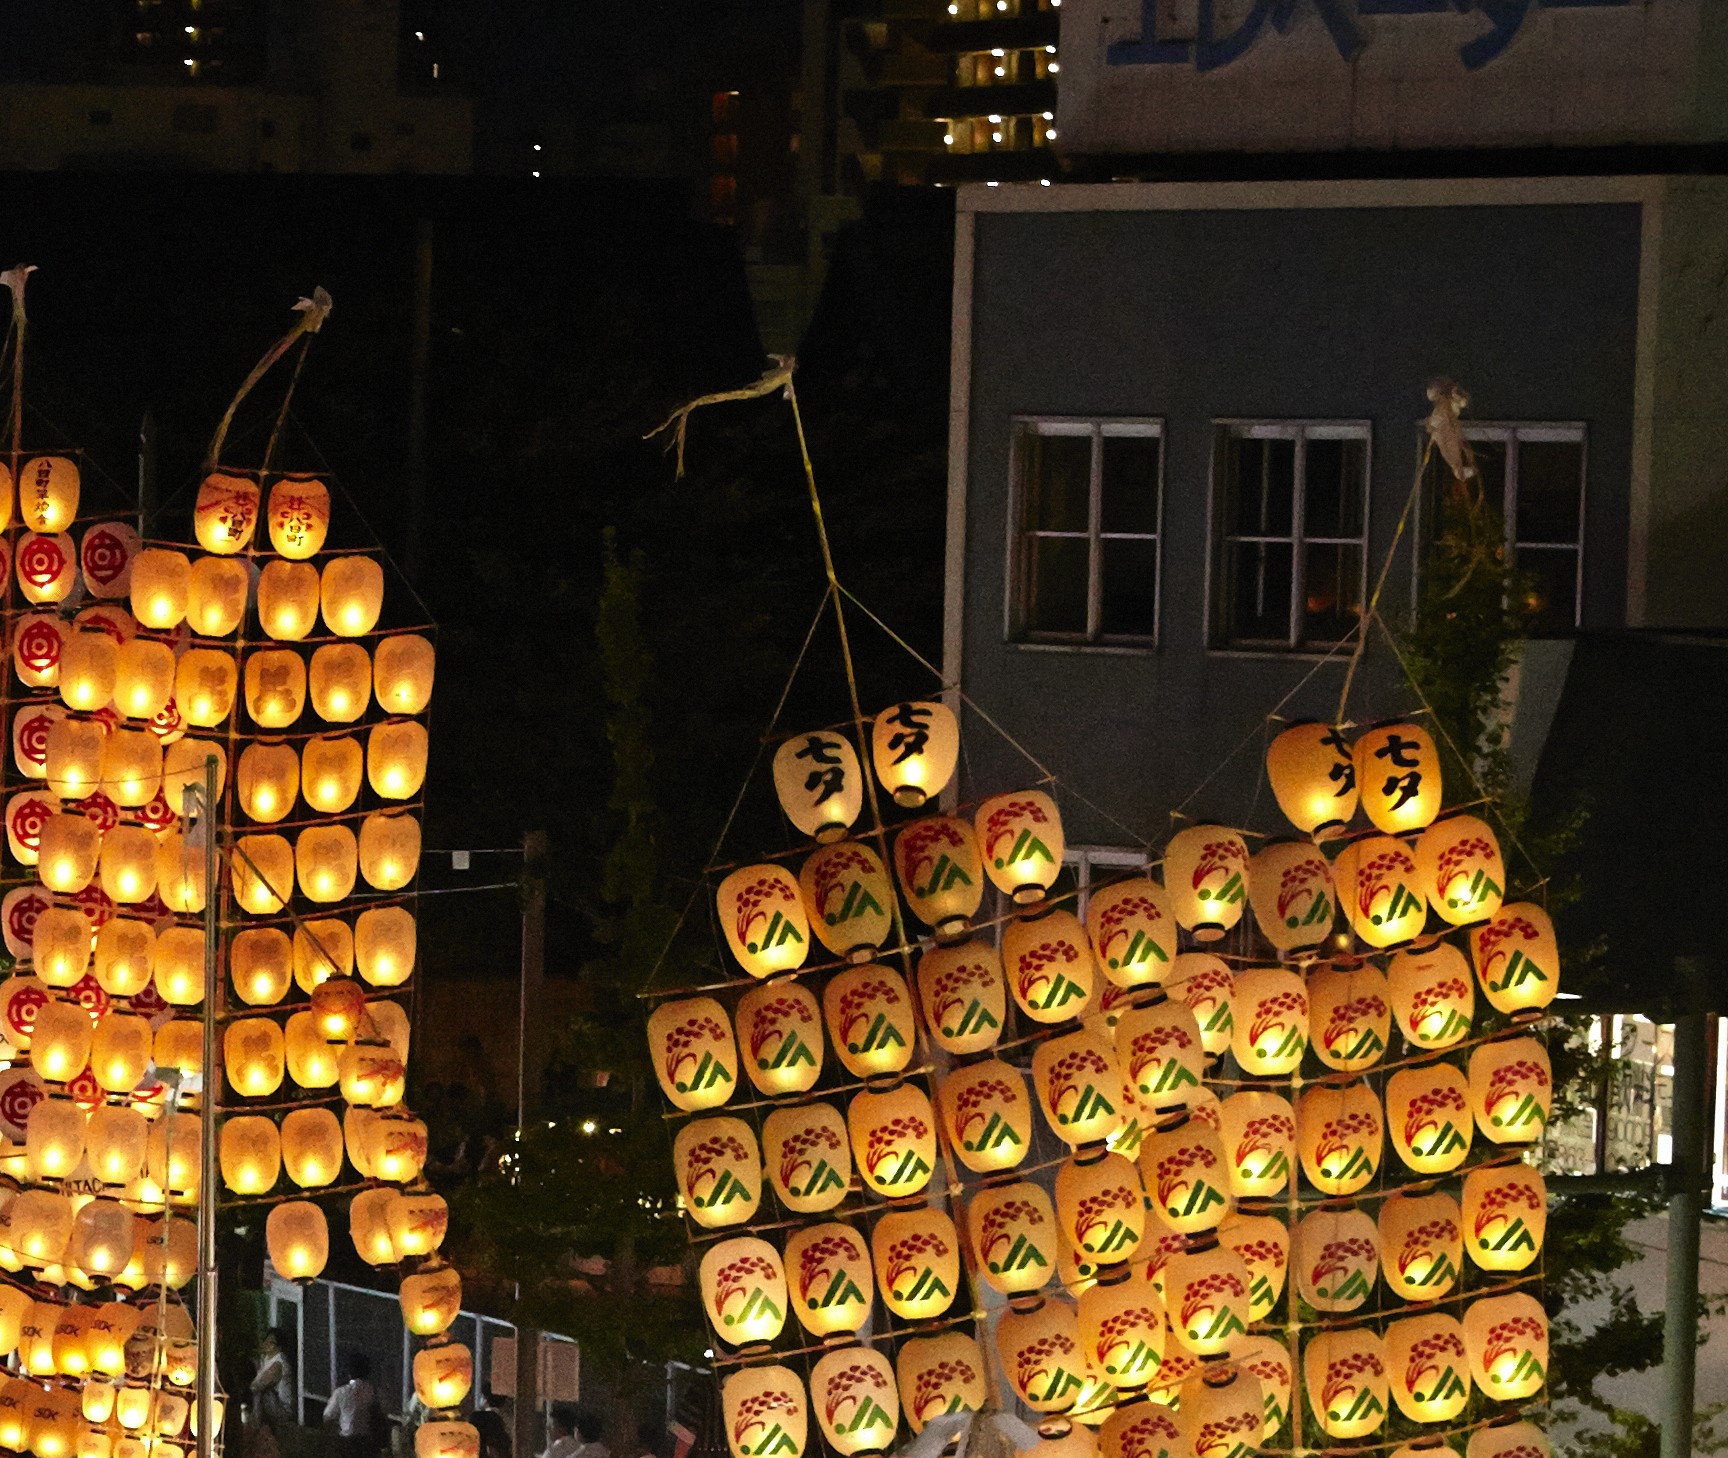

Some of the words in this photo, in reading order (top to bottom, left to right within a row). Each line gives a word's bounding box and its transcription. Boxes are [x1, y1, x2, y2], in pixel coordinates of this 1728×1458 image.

[885, 704, 930, 765] 七夕
[795, 738, 846, 809] 七夕
[1375, 735, 1422, 813] 七夕
